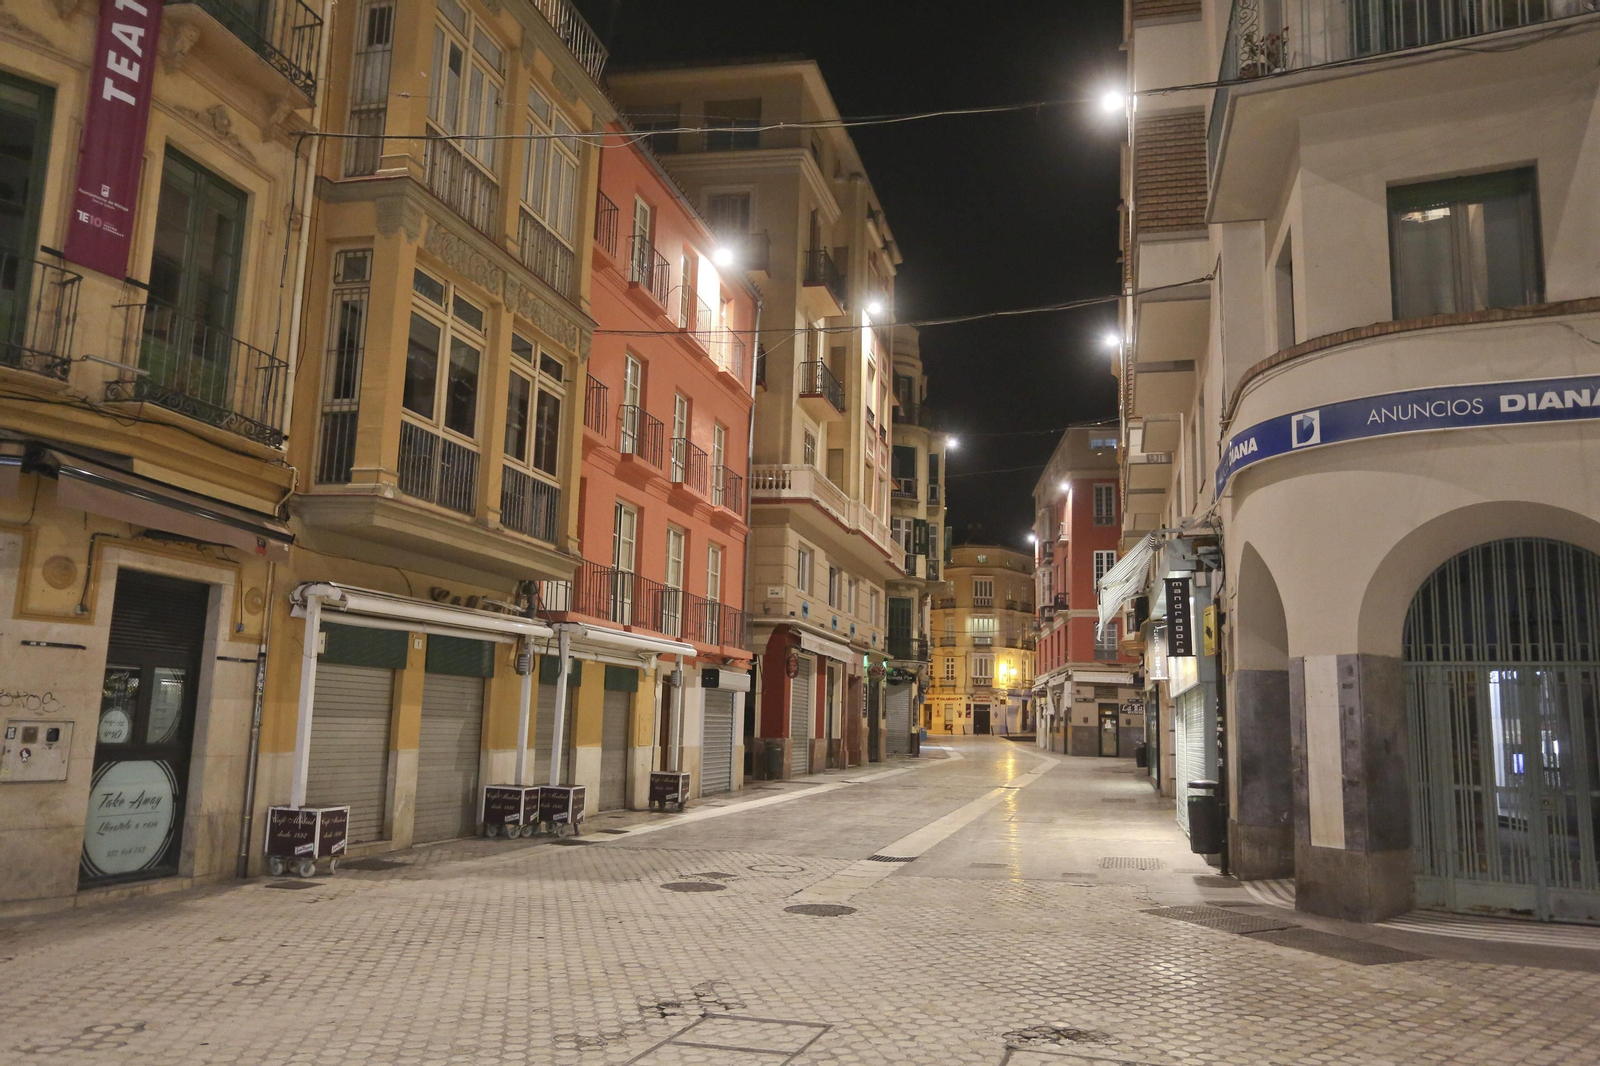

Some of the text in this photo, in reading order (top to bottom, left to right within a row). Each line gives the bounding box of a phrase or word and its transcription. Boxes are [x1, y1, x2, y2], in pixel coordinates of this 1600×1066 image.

[1367, 398, 1484, 425] ANUNCIOS
[1172, 581, 1184, 654] mandragora
[98, 790, 163, 810] Take Away
